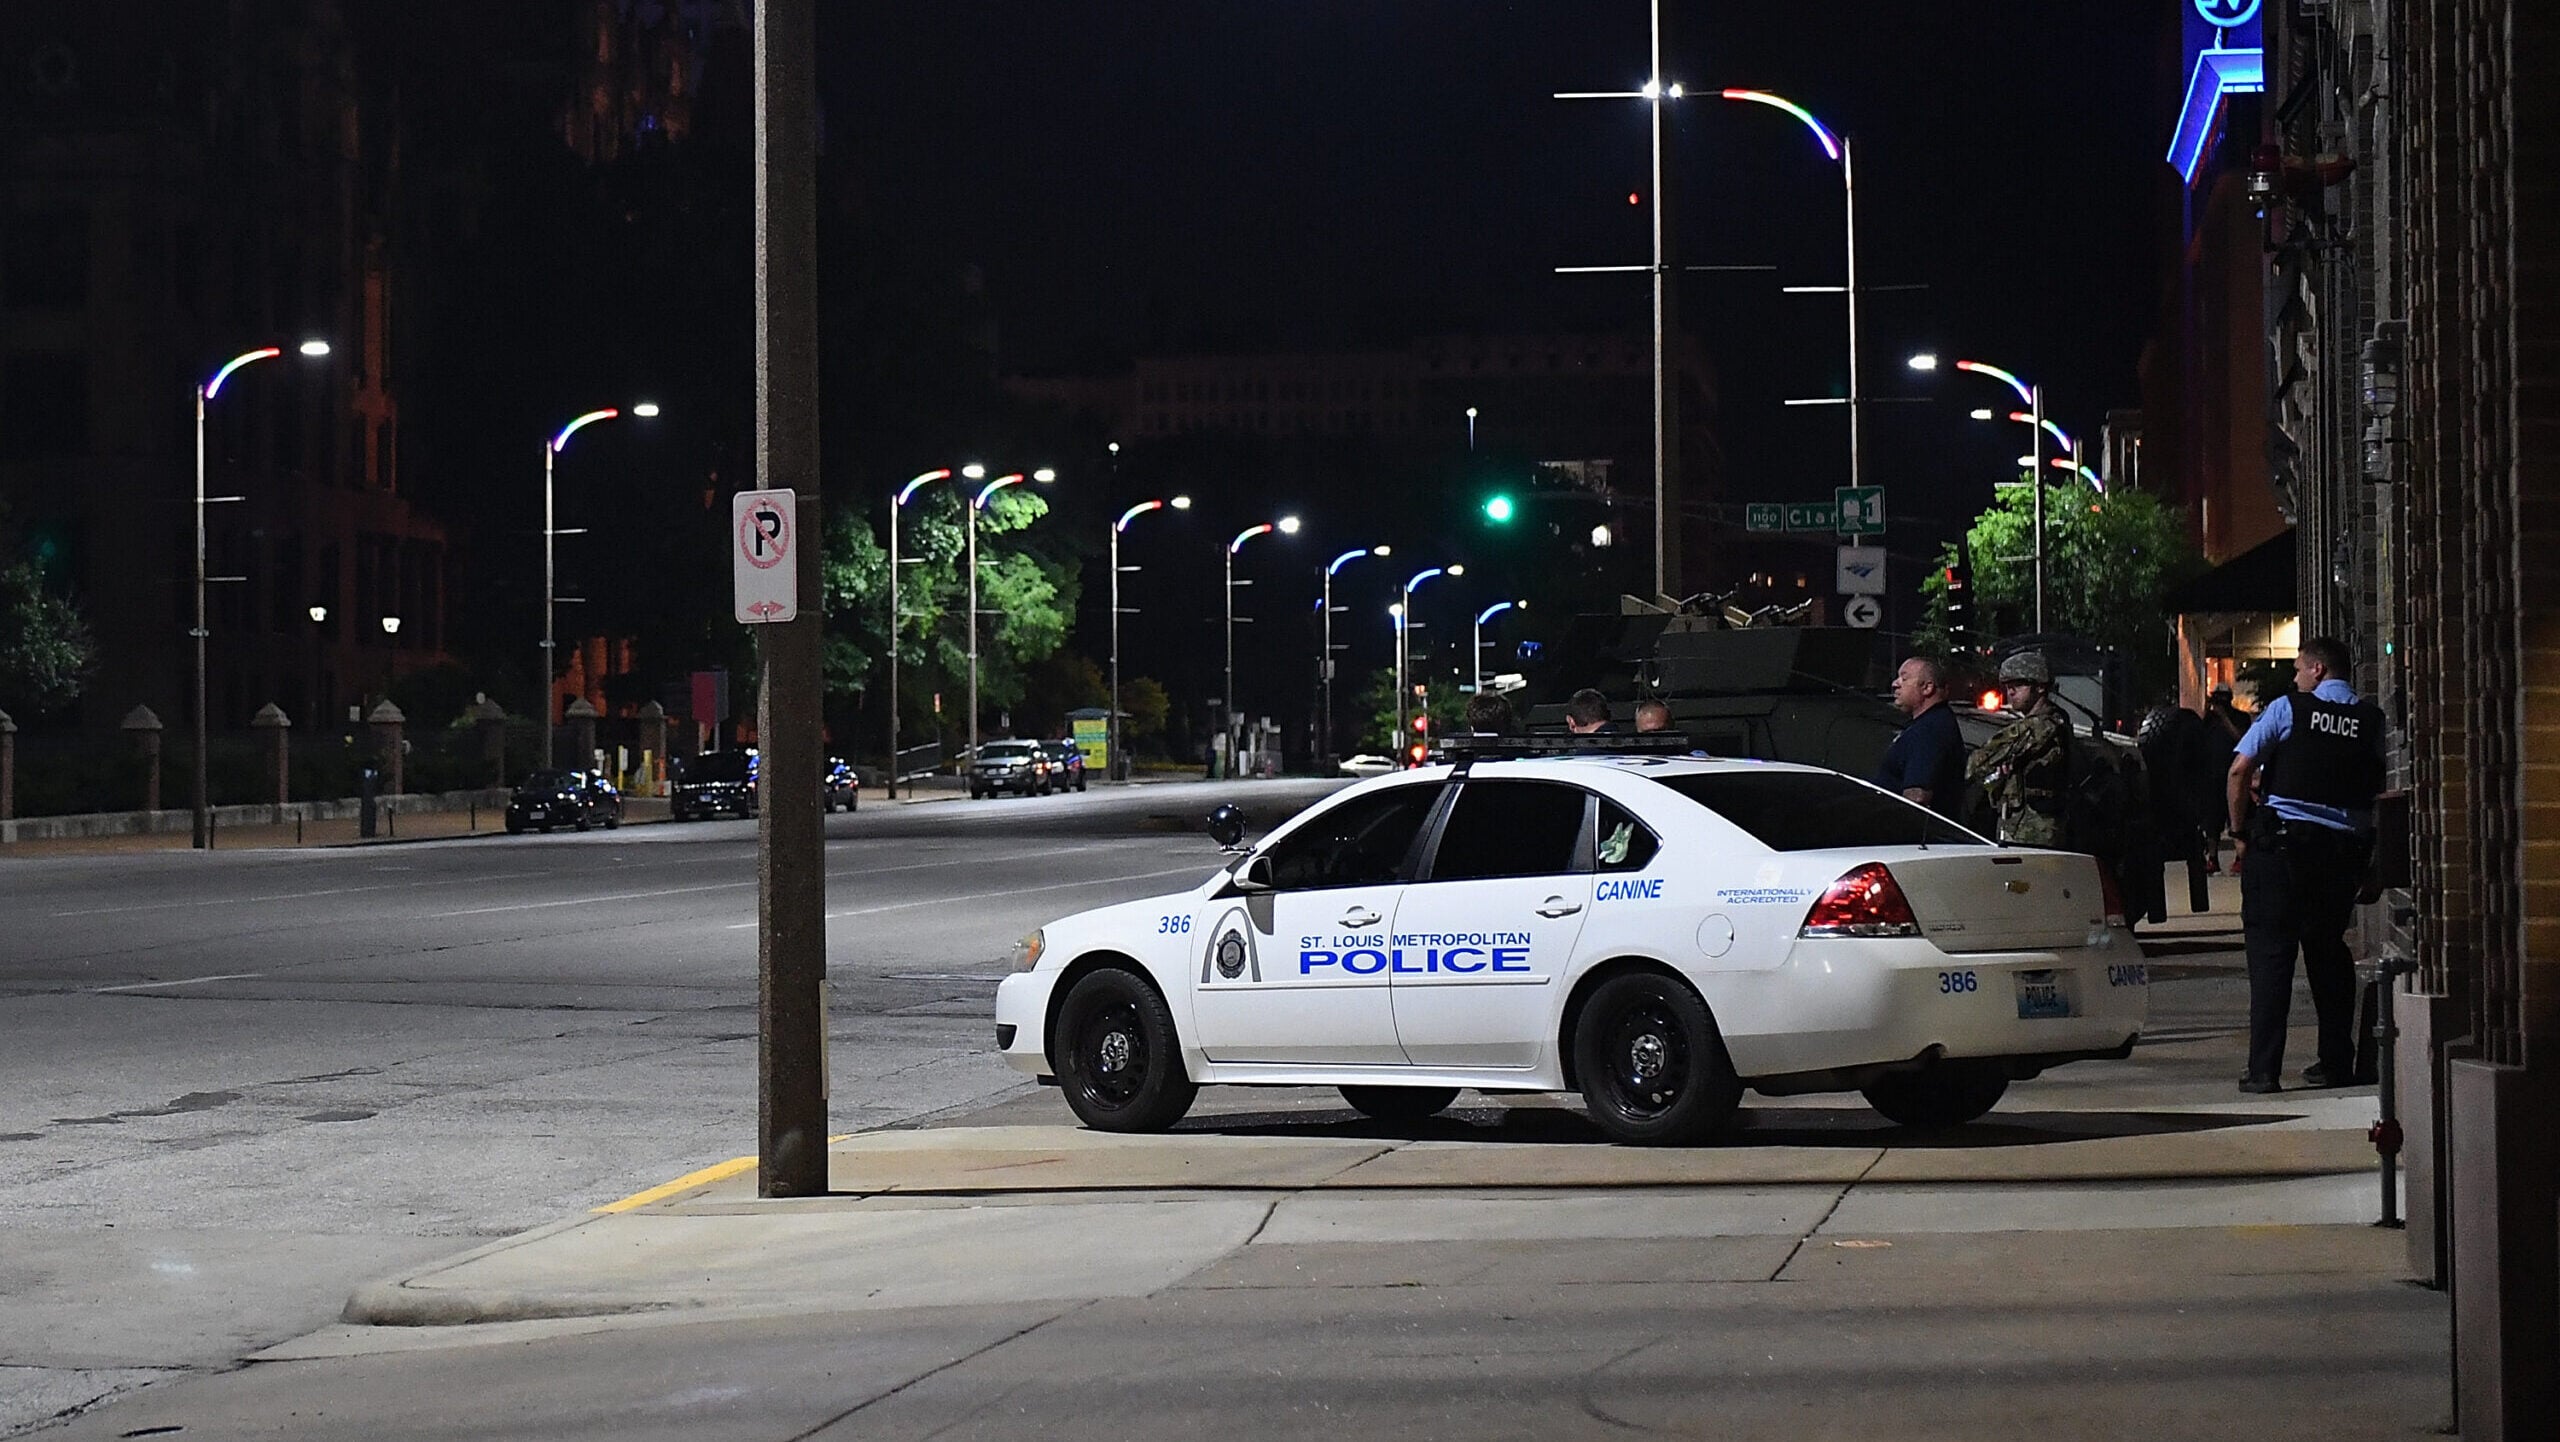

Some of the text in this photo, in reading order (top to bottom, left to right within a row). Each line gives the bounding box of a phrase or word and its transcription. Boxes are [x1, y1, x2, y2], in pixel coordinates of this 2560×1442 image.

[1753, 512, 1777, 523] 1100
[2310, 711, 2360, 738] POLICE
[1597, 879, 1664, 901] CANINE
[1717, 888, 1814, 897] INTERNATIONALLY
[1726, 896, 1799, 904] ACCREDITED
[1158, 914, 1191, 934] 386
[1300, 932, 1531, 949] ST. LOUIS METROPOLITAN
[1300, 948, 1531, 974] POLICE
[1939, 971, 1977, 993] 386
[2108, 964, 2147, 987] CANINE
